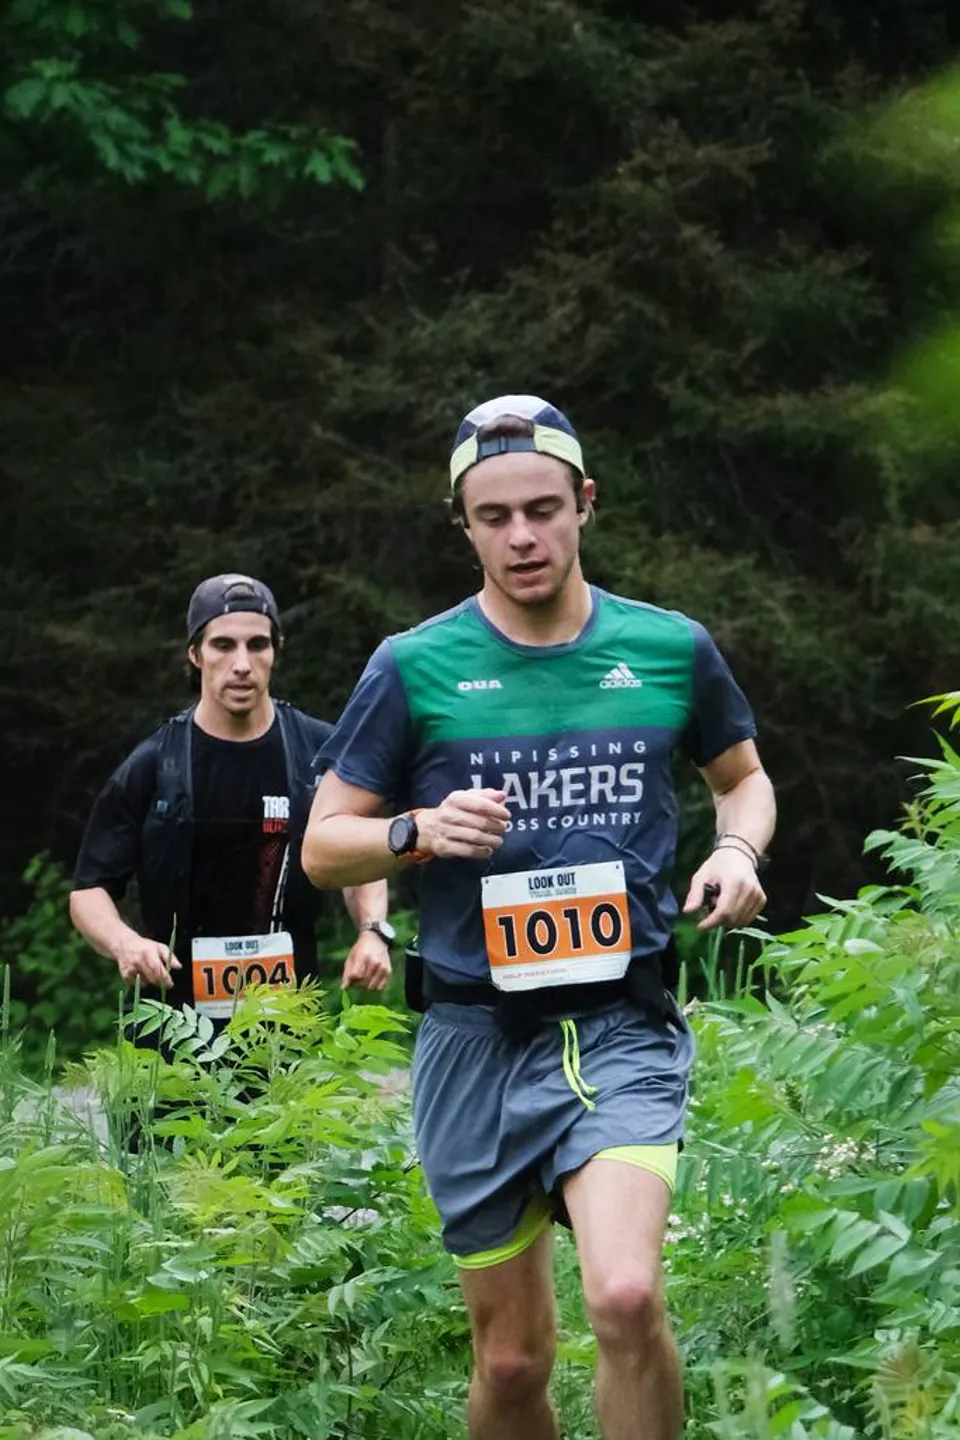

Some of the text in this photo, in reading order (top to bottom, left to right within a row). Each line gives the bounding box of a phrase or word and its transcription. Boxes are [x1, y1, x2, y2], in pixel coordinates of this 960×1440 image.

[599, 678, 642, 689] adidas
[470, 741, 647, 765] NIPISSING
[505, 811, 642, 833] OSS COUNTRY
[528, 871, 576, 890] LOOK OUT
[497, 902, 623, 958] 1010
[203, 961, 291, 996] 1004
